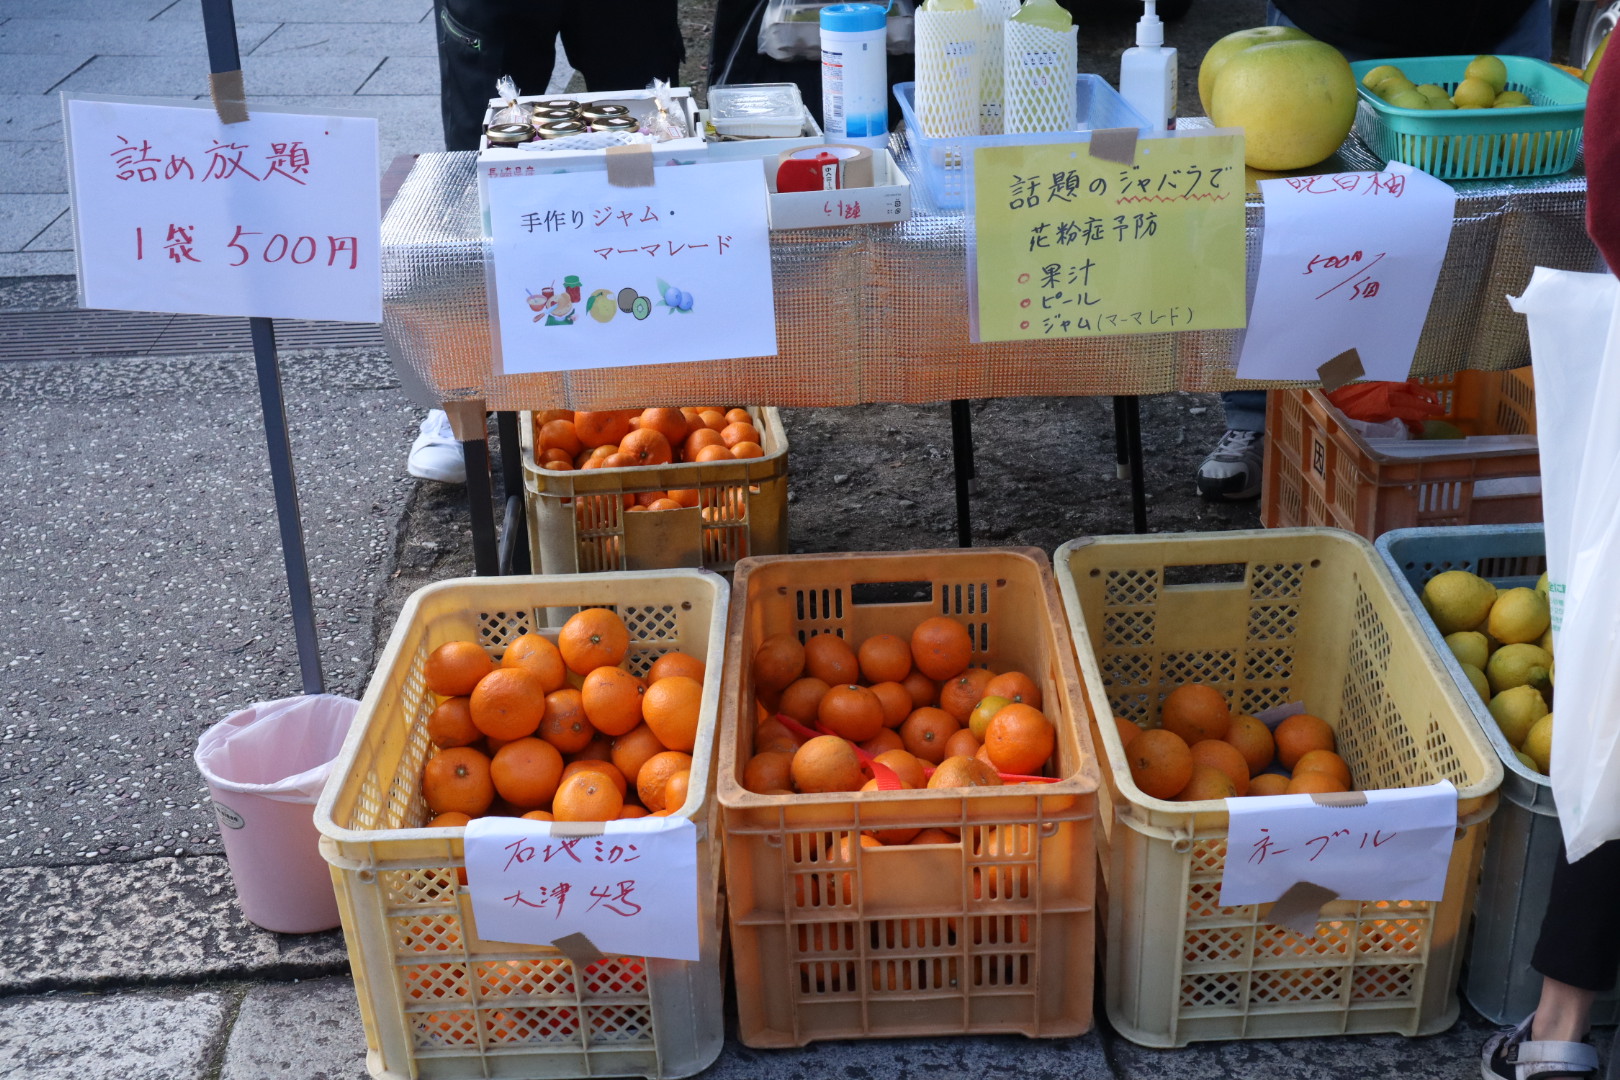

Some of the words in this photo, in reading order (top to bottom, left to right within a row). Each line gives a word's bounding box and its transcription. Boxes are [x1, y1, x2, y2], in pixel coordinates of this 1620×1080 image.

[110, 136, 310, 186] 詰め放題
[1009, 165, 1233, 210] 話題のジャバラで
[593, 235, 733, 261] マーマレード
[1029, 212, 1158, 252] 花粉症予防
[1040, 258, 1096, 289] 果汁
[1042, 291, 1102, 309] ピール
[1248, 828, 1397, 865] ネーブル
